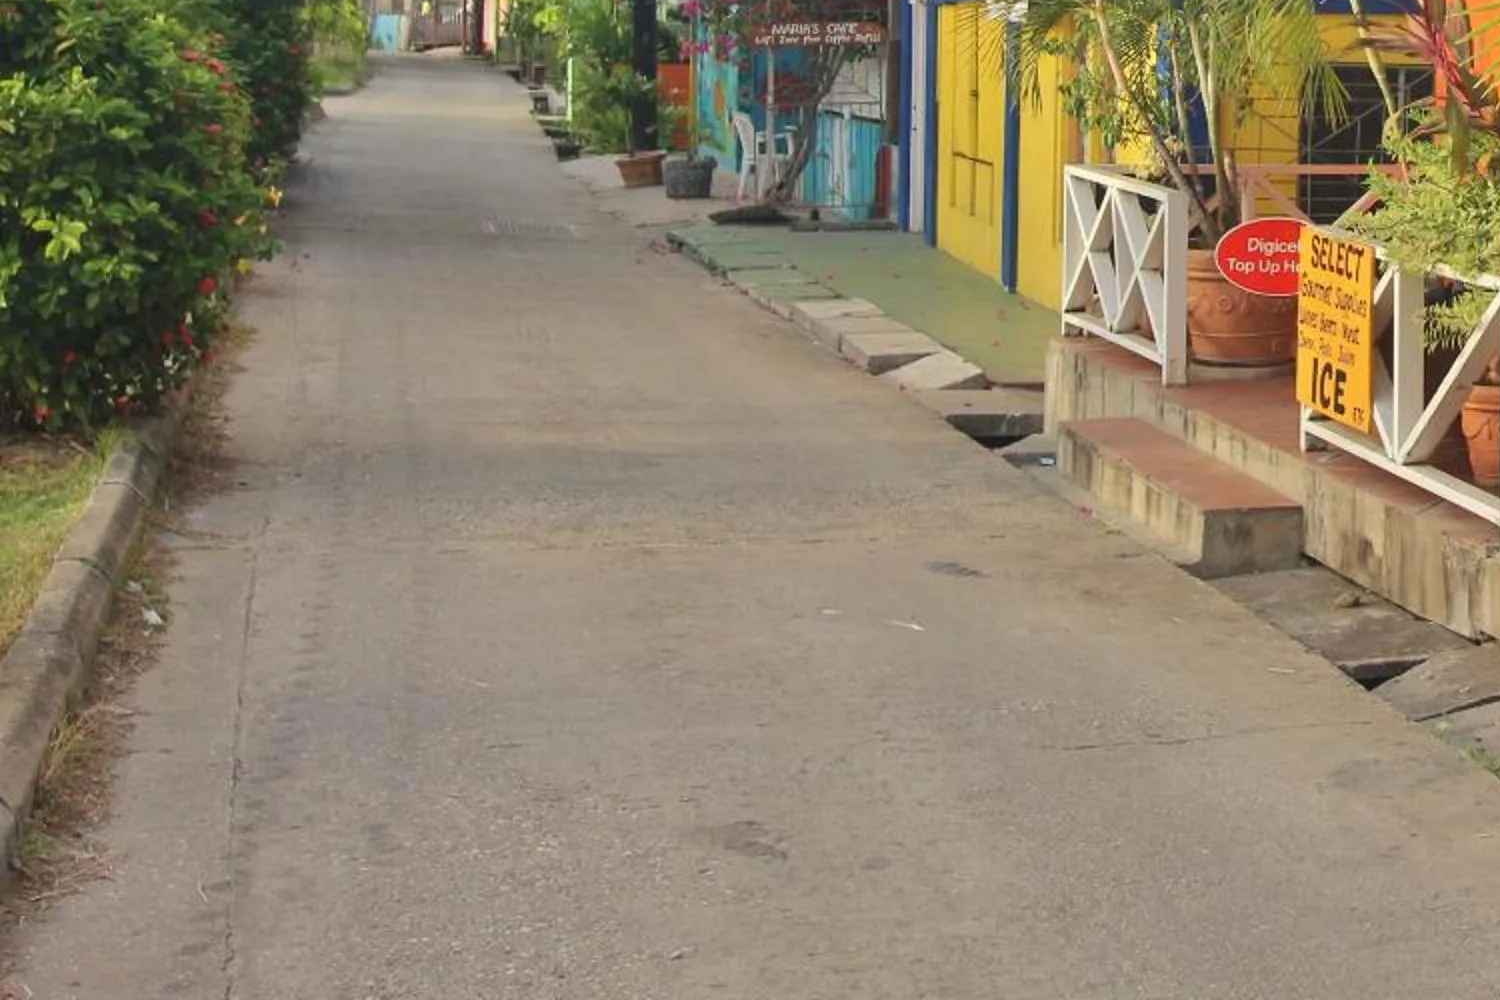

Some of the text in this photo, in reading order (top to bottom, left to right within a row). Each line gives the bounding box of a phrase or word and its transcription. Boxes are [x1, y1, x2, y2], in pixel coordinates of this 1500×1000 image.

[1226, 257, 1256, 275] Top
[1258, 259, 1281, 275] Up
[1311, 234, 1366, 283] SELECT
[1311, 357, 1348, 416] ICE
